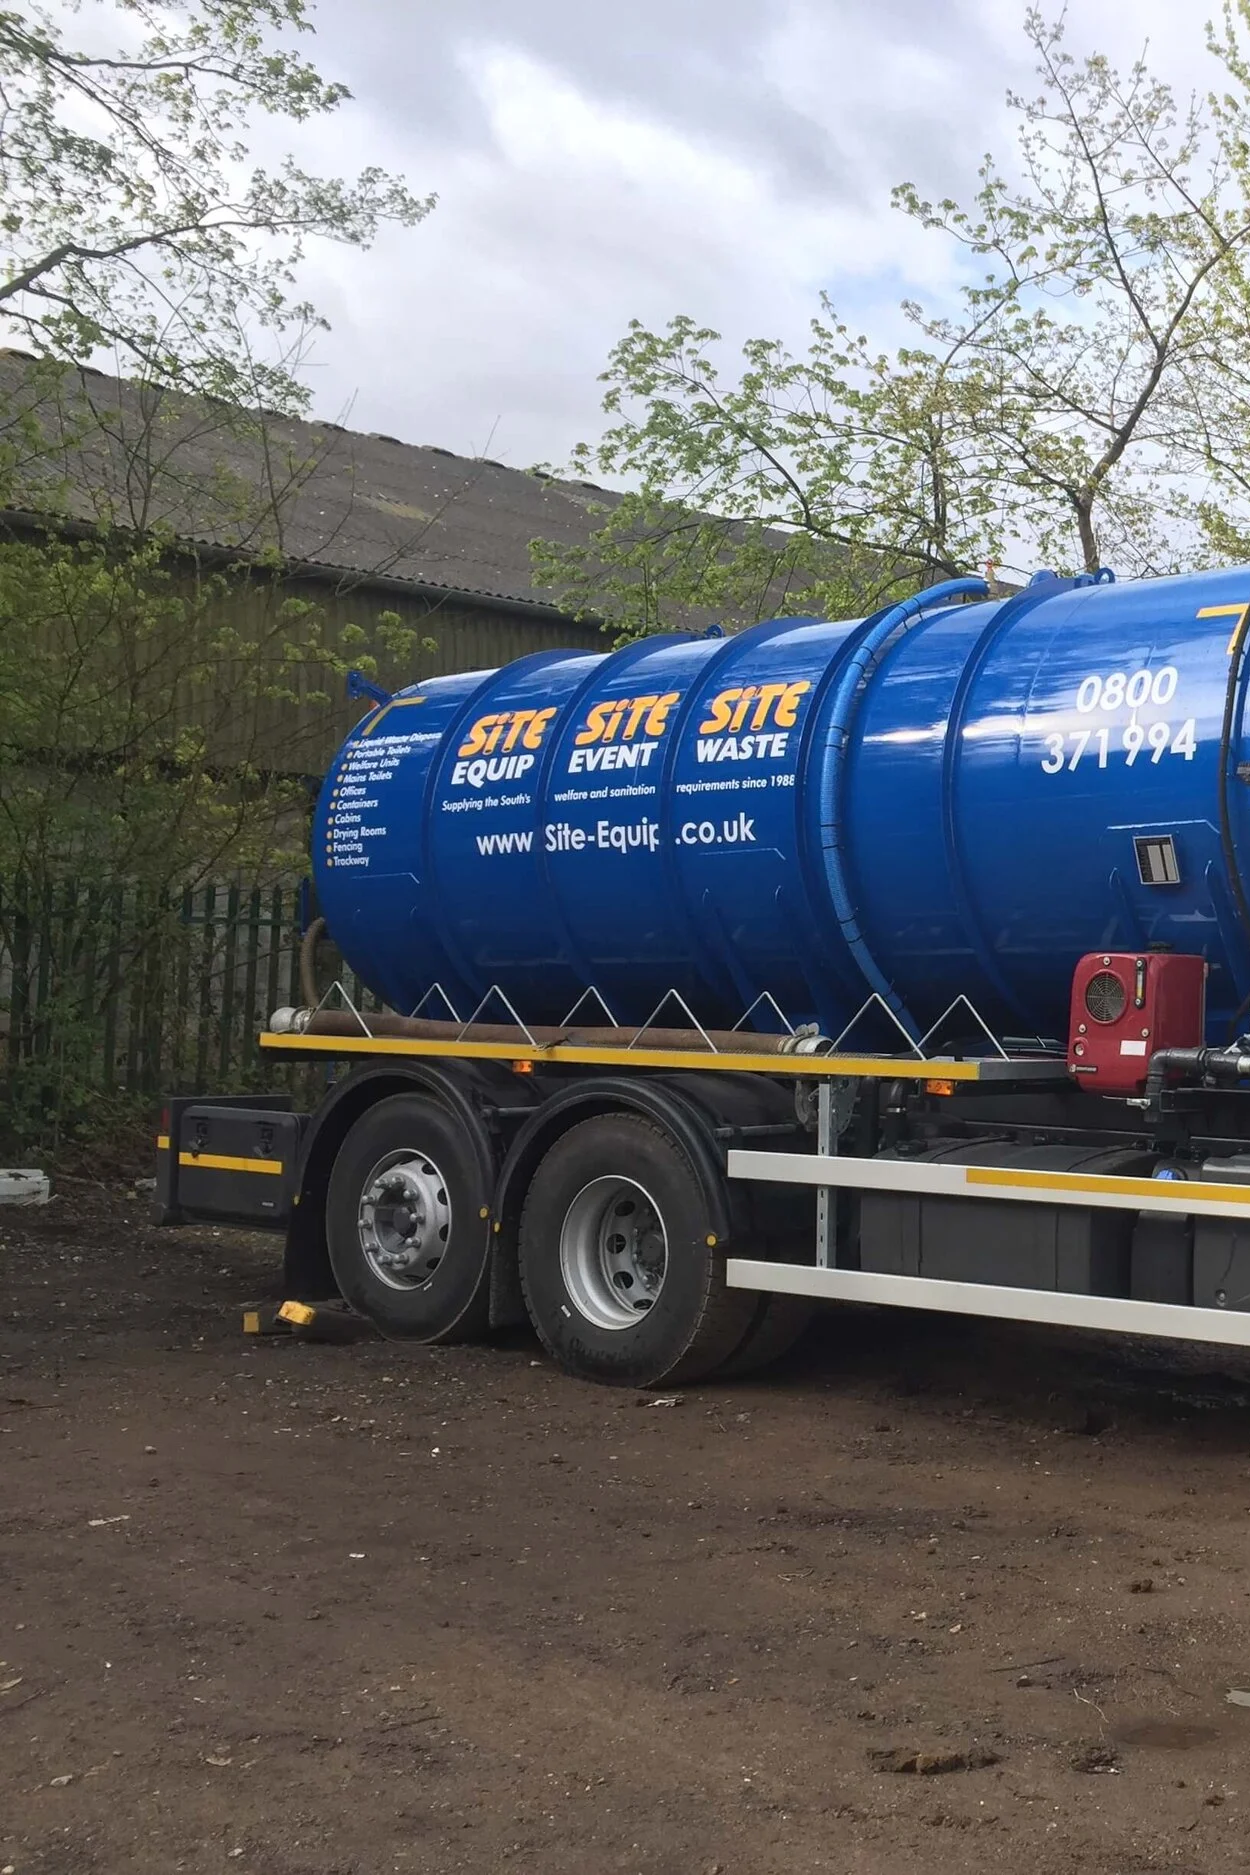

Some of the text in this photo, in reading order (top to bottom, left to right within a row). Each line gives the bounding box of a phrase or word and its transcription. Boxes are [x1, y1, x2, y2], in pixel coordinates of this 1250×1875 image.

[1076, 665, 1179, 714] 0800
[353, 745, 412, 759] Portable Toilets
[697, 732, 789, 763] WASTE
[1041, 718, 1197, 774] 371 994
[348, 757, 400, 771] Welfare Units
[568, 741, 660, 774] EVENT
[343, 770, 393, 784] Mains Toilets
[451, 754, 535, 788] EQUIP
[339, 786, 366, 797] Offices
[441, 774, 796, 813] Supplying the South's welfare and sanitation requirements since 1988
[337, 799, 378, 810] Containers
[335, 813, 361, 824] Cabins
[333, 826, 387, 840] Drying Rooms
[476, 831, 533, 856] www
[675, 812, 757, 845] .co.uk
[333, 841, 363, 853] Fencing
[333, 855, 370, 867] Trackway
